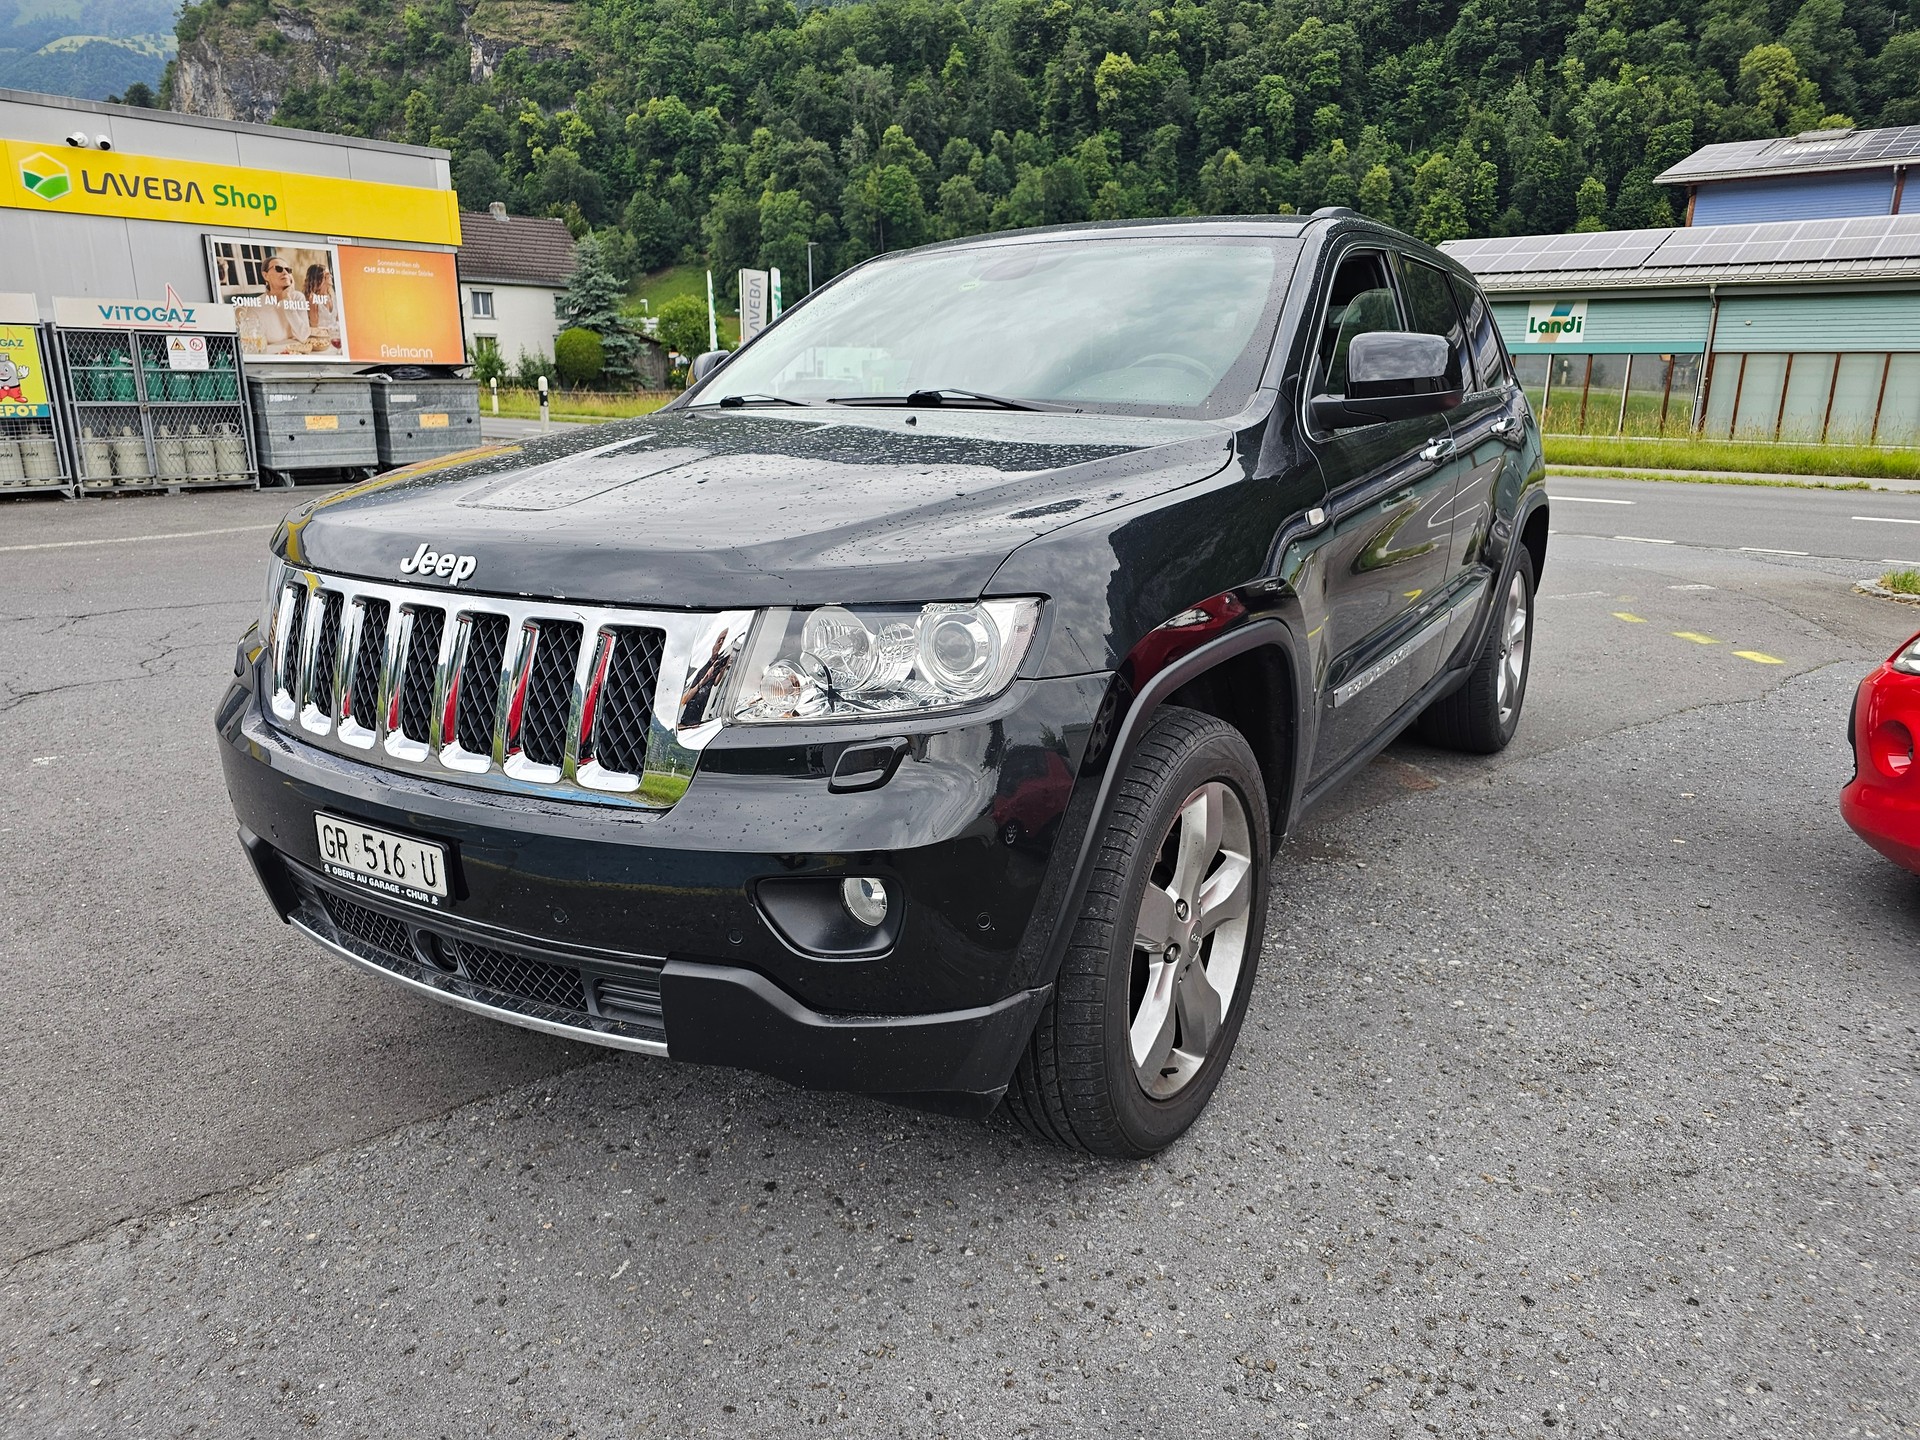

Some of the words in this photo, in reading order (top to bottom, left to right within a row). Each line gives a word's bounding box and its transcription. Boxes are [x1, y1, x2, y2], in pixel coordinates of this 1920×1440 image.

[81, 169, 205, 205] LAVEBA
[212, 184, 278, 217] Shop
[363, 266, 376, 274] CHF
[231, 295, 262, 308] SONNE
[283, 299, 311, 311] BRILLE
[312, 294, 329, 305] AUF
[1529, 316, 1583, 334] Landi
[400, 543, 478, 587] Jeep
[323, 824, 351, 864] GR
[362, 833, 407, 879] 516
[420, 850, 438, 888] U
[332, 866, 356, 881] OBERE
[356, 873, 368, 884] AU
[369, 877, 400, 894] GARAGE
[406, 888, 429, 904] CHUR
